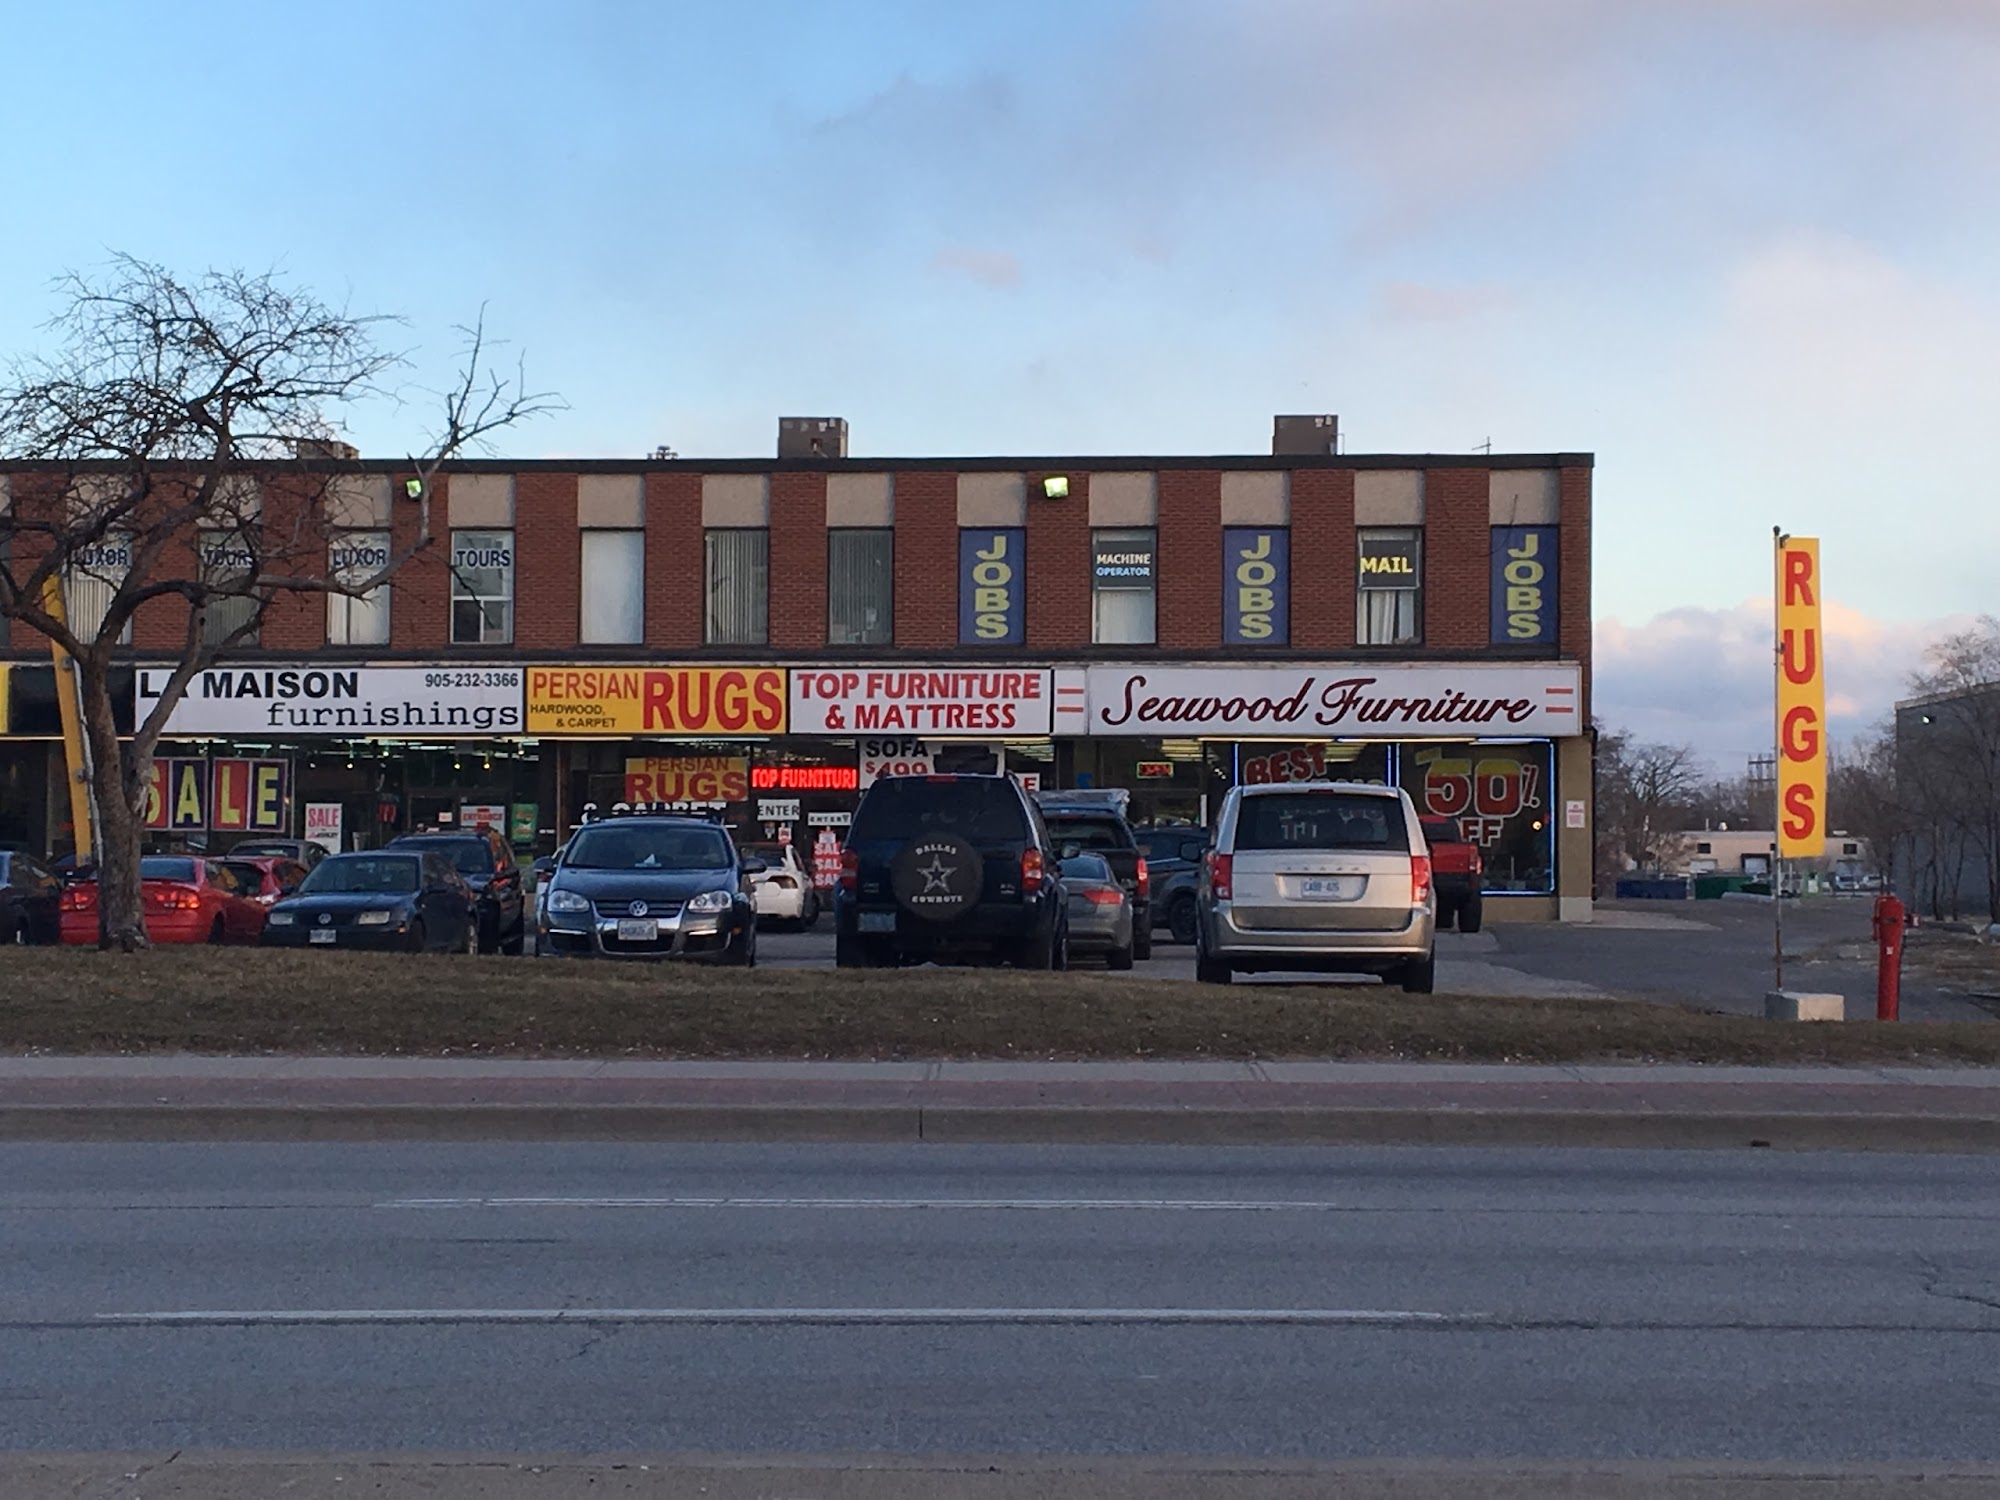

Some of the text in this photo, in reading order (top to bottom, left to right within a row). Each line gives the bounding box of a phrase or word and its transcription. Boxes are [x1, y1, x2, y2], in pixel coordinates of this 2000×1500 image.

[333, 549, 386, 566] LUXOR
[456, 550, 511, 567] TOURS
[1096, 553, 1151, 564] MACHINE
[1360, 556, 1413, 573] MAIL
[1096, 567, 1151, 577] OPERATOR
[973, 535, 1012, 639] JOBS
[1236, 535, 1276, 638] JOBS
[1504, 533, 1544, 638] JOBS
[203, 672, 358, 699] MAISON
[425, 673, 518, 687] 905-232-3366
[532, 672, 638, 700] PERSIAN
[797, 673, 1041, 699] TOP FURNITURE
[642, 671, 782, 731] RUGS
[1101, 675, 1537, 726] Seawood Furniture
[1782, 550, 1819, 840] RUGS
[267, 701, 519, 729] furnishings
[555, 718, 617, 728] & CARPET
[825, 703, 1016, 729] & MATTRESS
[866, 740, 929, 758] SOFA
[645, 757, 729, 772] PERSIAN
[1244, 742, 1327, 784] BEST
[625, 771, 748, 803] RUGS
[1425, 758, 1540, 818] 50%
[308, 808, 339, 827] SALE
[758, 805, 799, 816] ENTER
[1455, 817, 1504, 847] FF
[814, 843, 840, 855] SAL
[915, 844, 957, 855] DALLAS
[815, 859, 842, 870] SAL
[911, 895, 963, 903] COWBOYS
